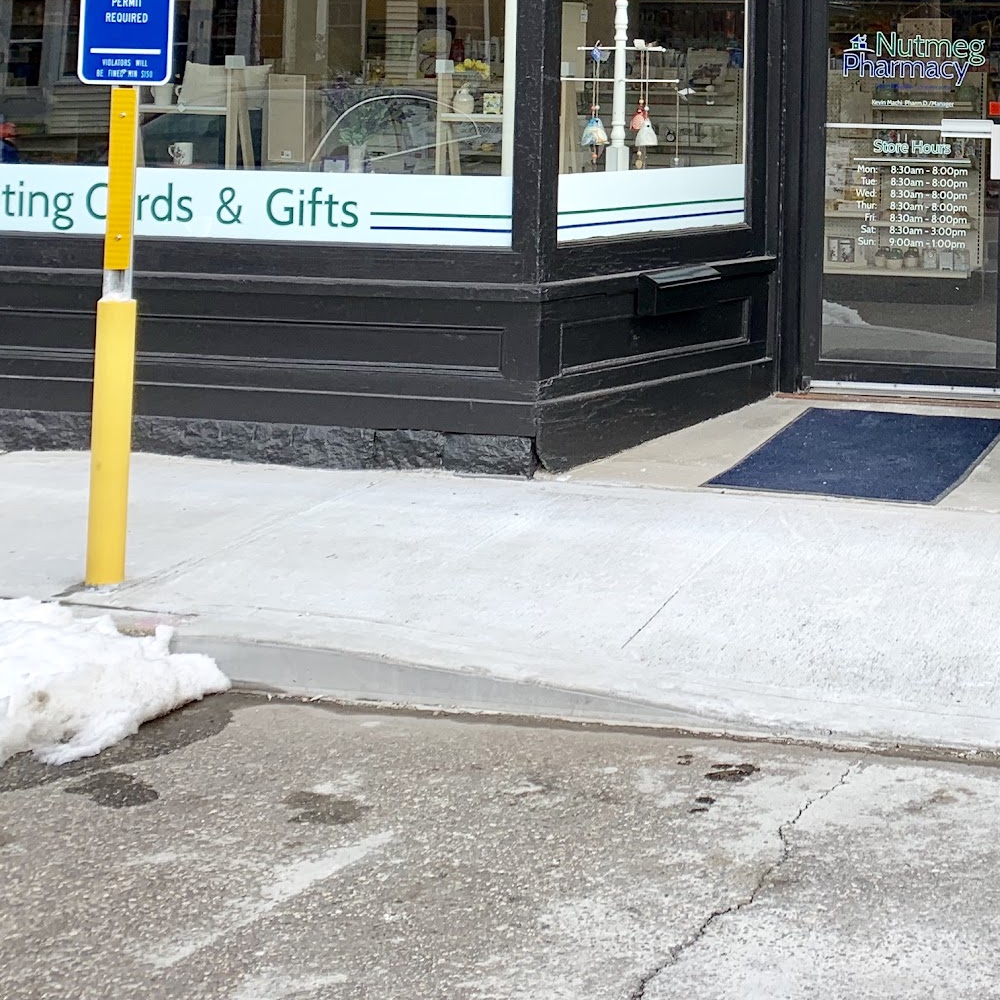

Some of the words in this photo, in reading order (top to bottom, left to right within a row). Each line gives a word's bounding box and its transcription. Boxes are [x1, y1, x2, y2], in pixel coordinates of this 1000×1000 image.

[105, 12, 148, 24] REQUIRED
[875, 31, 986, 67] Nutmeg
[102, 58, 131, 67] VIOLATORS
[135, 59, 148, 67] WILL
[96, 69, 104, 77] BE
[842, 53, 970, 87] Pharmacy
[873, 139, 909, 154] Store
[911, 141, 952, 155] Hours
[857, 165, 878, 174] Mon:
[890, 165, 924, 175] 8:30am
[932, 166, 968, 177] 8:00pm
[861, 177, 878, 186] Tue:
[890, 177, 924, 187] 8:30am
[932, 179, 968, 189] 8:00pm
[855, 188, 878, 198] Wed:
[890, 189, 924, 199] 8:30am
[932, 191, 968, 201] 8:00pm
[86, 182, 194, 223] Crds
[215, 186, 243, 225] &
[266, 187, 360, 228] Gifts
[856, 201, 878, 210] Thur:
[889, 201, 924, 211] 8:30am
[932, 203, 968, 213] 8:00pm
[864, 213, 877, 222] Fri:
[889, 213, 924, 224] 8:30am
[931, 215, 968, 225] 8:00pm
[860, 225, 877, 235] Sat:
[889, 225, 923, 236] 8:30am
[931, 227, 967, 238] 3:00pm
[857, 237, 877, 247] Sun:
[888, 237, 924, 248] 9:00am
[932, 240, 966, 250] 1:00pm
